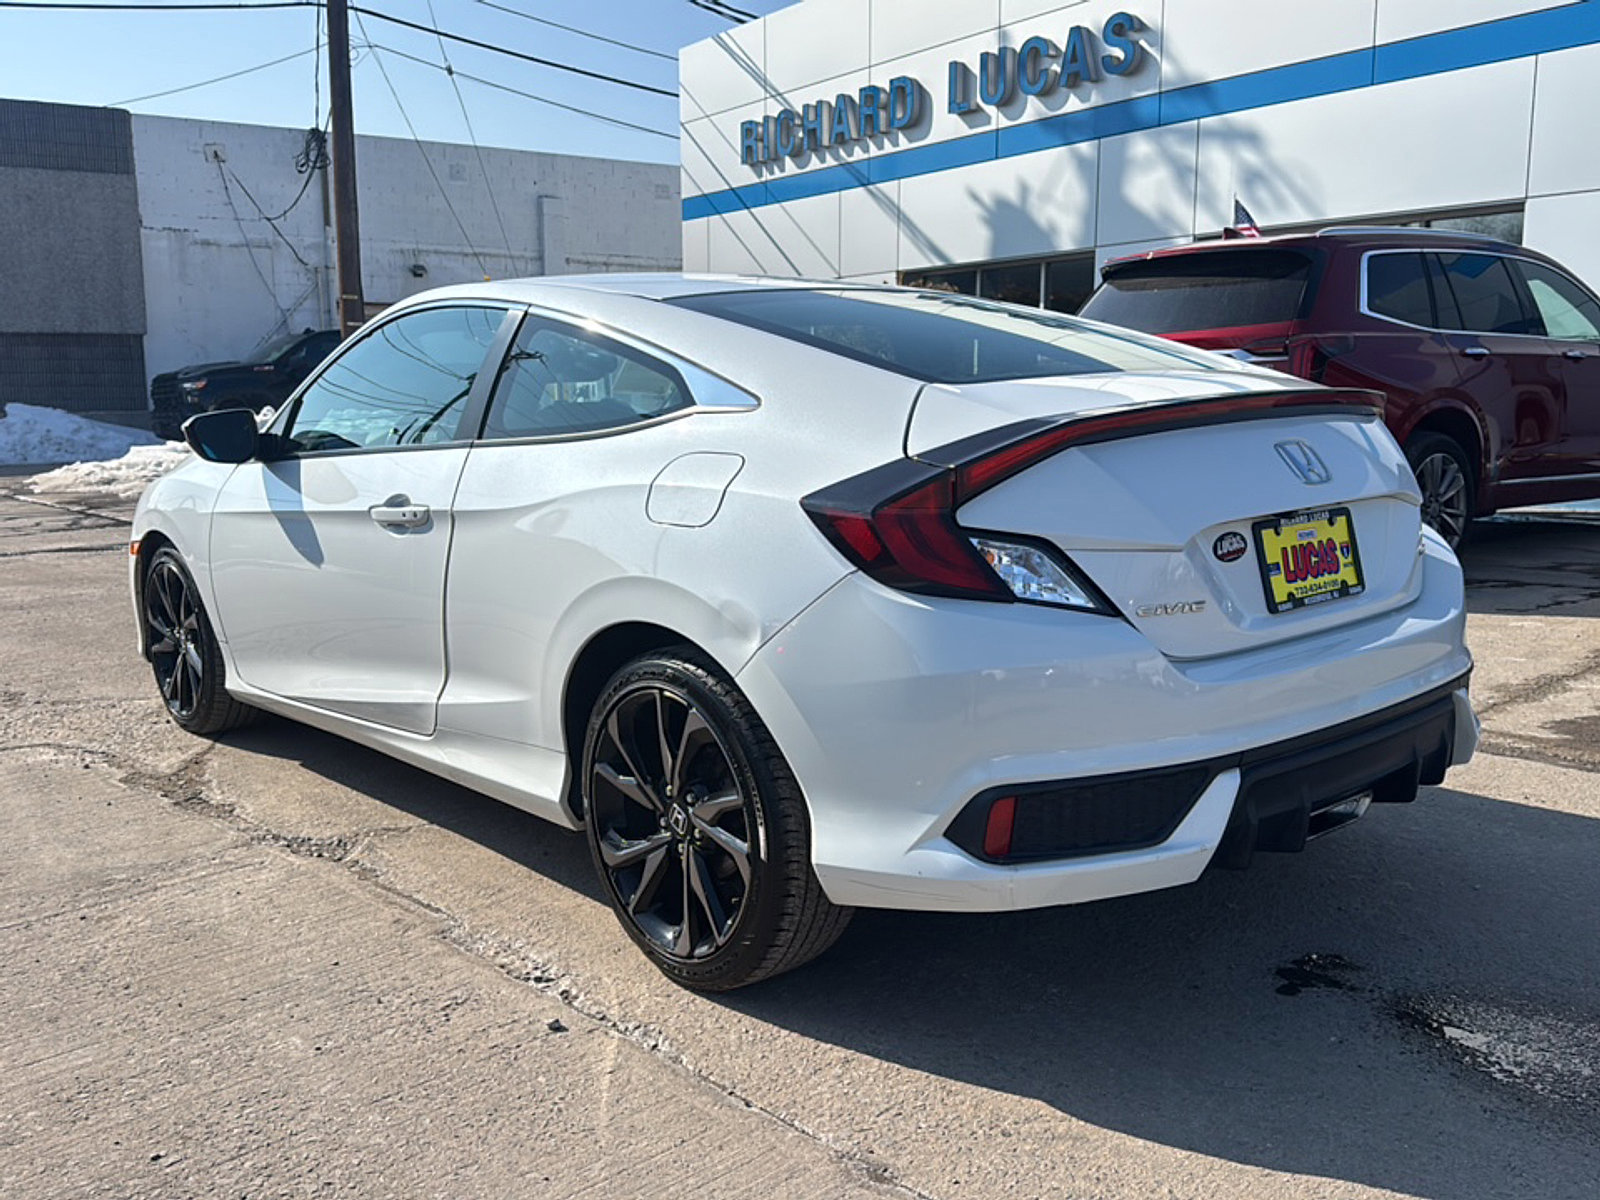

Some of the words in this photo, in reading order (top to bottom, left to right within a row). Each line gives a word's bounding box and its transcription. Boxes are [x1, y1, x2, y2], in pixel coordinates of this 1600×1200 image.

[741, 75, 923, 166] RICHARD
[948, 11, 1143, 114] LUCAS
[1215, 534, 1246, 555] LUCAS
[1281, 538, 1340, 584] LUCAS
[1136, 600, 1206, 617] CIVIC
